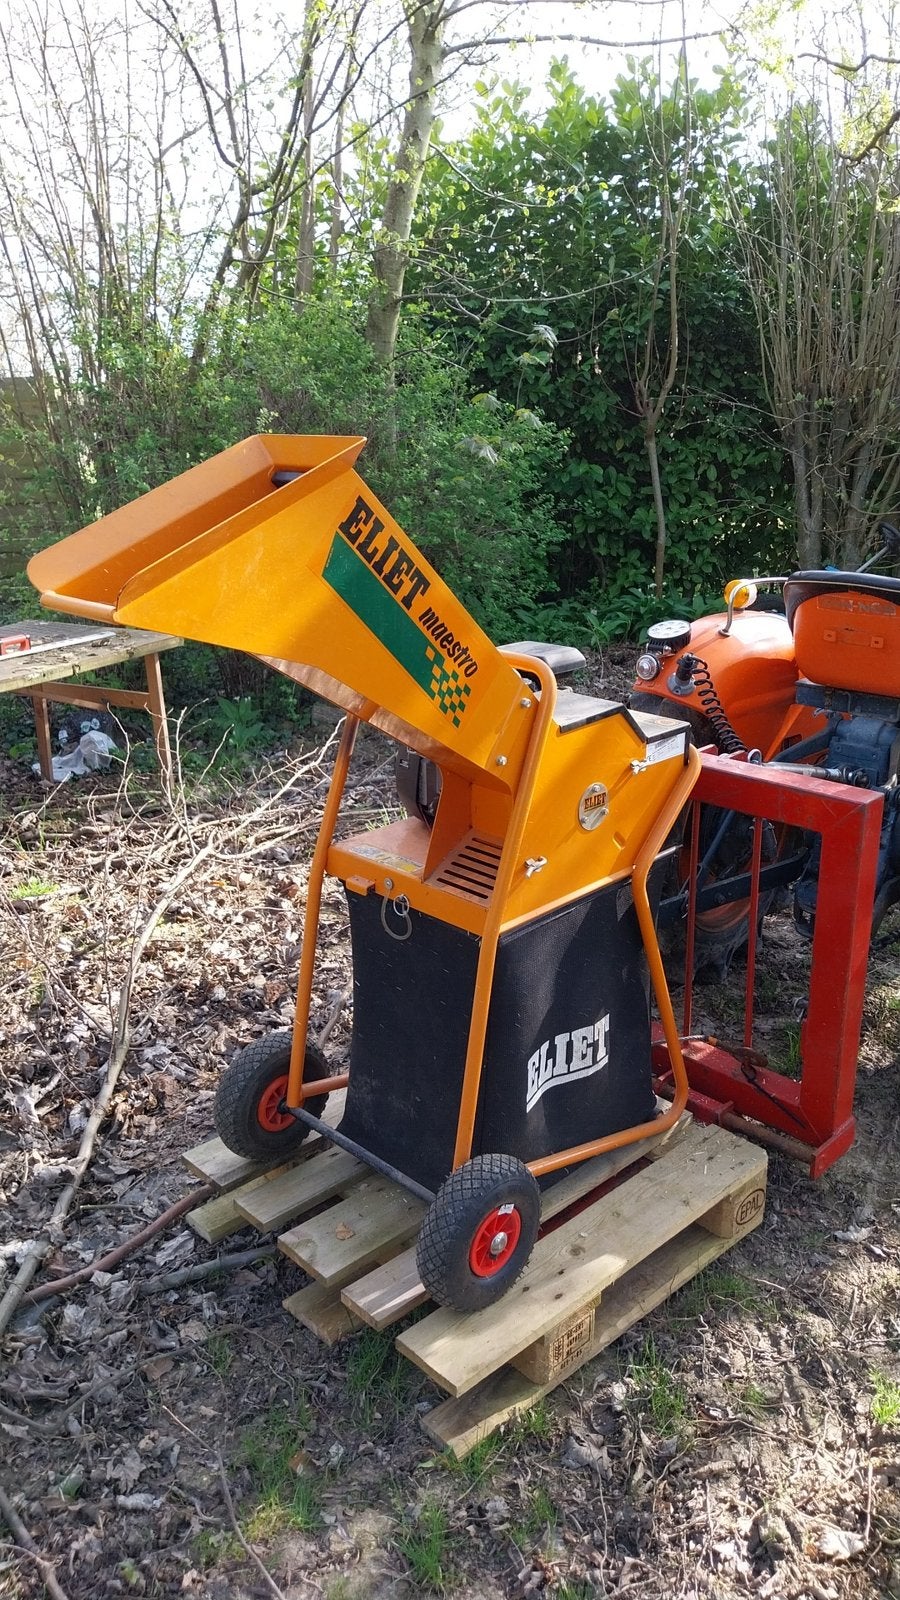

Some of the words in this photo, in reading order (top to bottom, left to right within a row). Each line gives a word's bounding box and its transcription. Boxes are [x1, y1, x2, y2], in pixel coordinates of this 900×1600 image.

[338, 495, 431, 611] ELIET
[418, 606, 479, 678] maestro
[584, 792, 607, 810] ELIET
[526, 1013, 610, 1103] ELIET
[740, 1193, 761, 1222] EPAL
